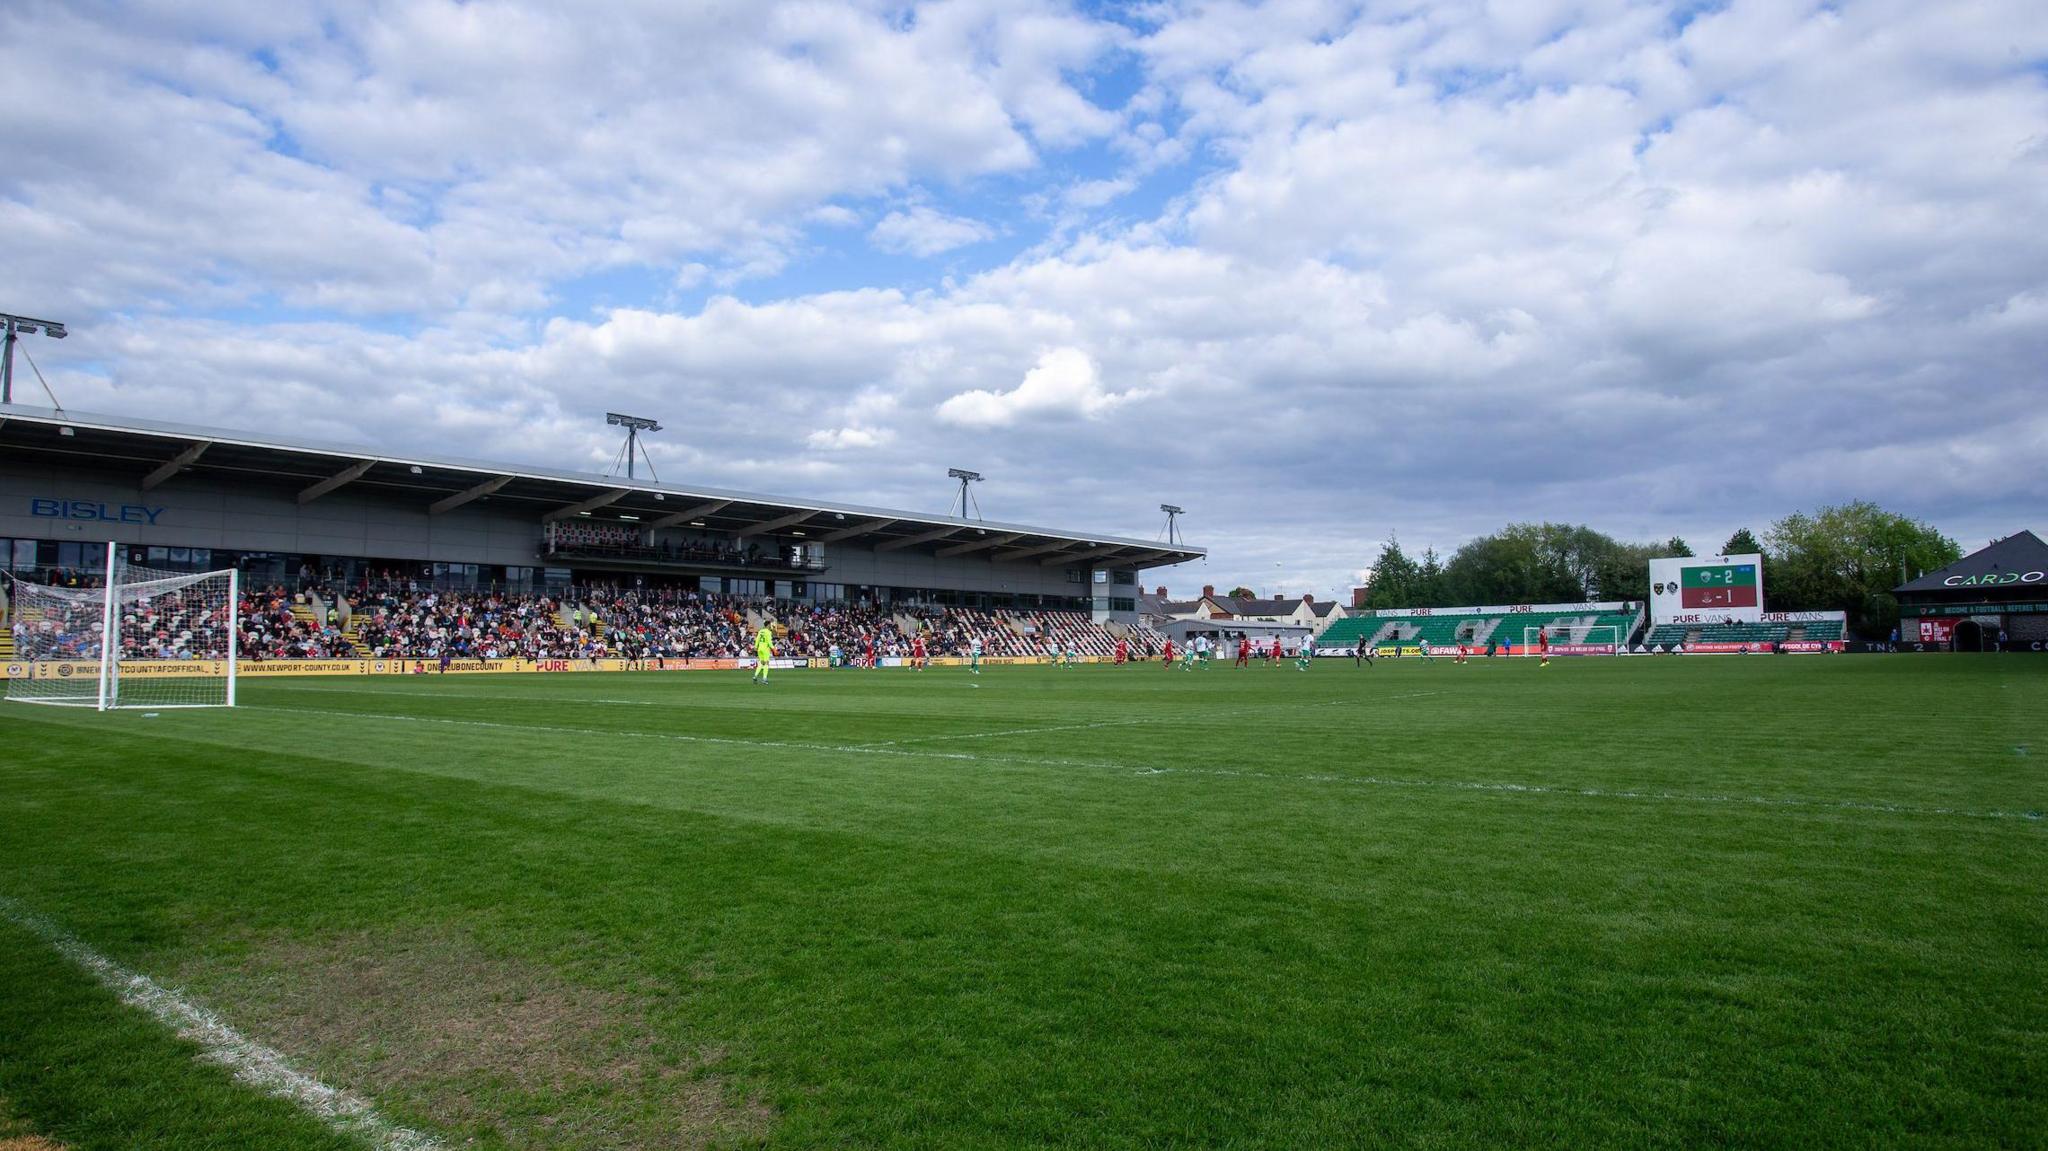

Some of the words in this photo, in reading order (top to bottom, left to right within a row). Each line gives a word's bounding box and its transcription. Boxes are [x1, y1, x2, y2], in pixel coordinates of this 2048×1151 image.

[31, 498, 166, 525] BISLEY
[135, 553, 142, 561] B
[1724, 569, 1733, 584] 2
[1944, 571, 2045, 586] CARDO
[1727, 589, 1732, 603] 1
[1410, 608, 1432, 616] PURE
[1510, 605, 1533, 613] PURE
[1573, 602, 1597, 610] VANS
[1673, 614, 1701, 624] PURE
[1760, 613, 1790, 622] PURE
[1792, 612, 1824, 620] VANS
[1913, 643, 1924, 652] 2
[243, 664, 351, 673] WWW.NEWPORT-COUNTY.CO.UK
[536, 660, 569, 671] PURE
